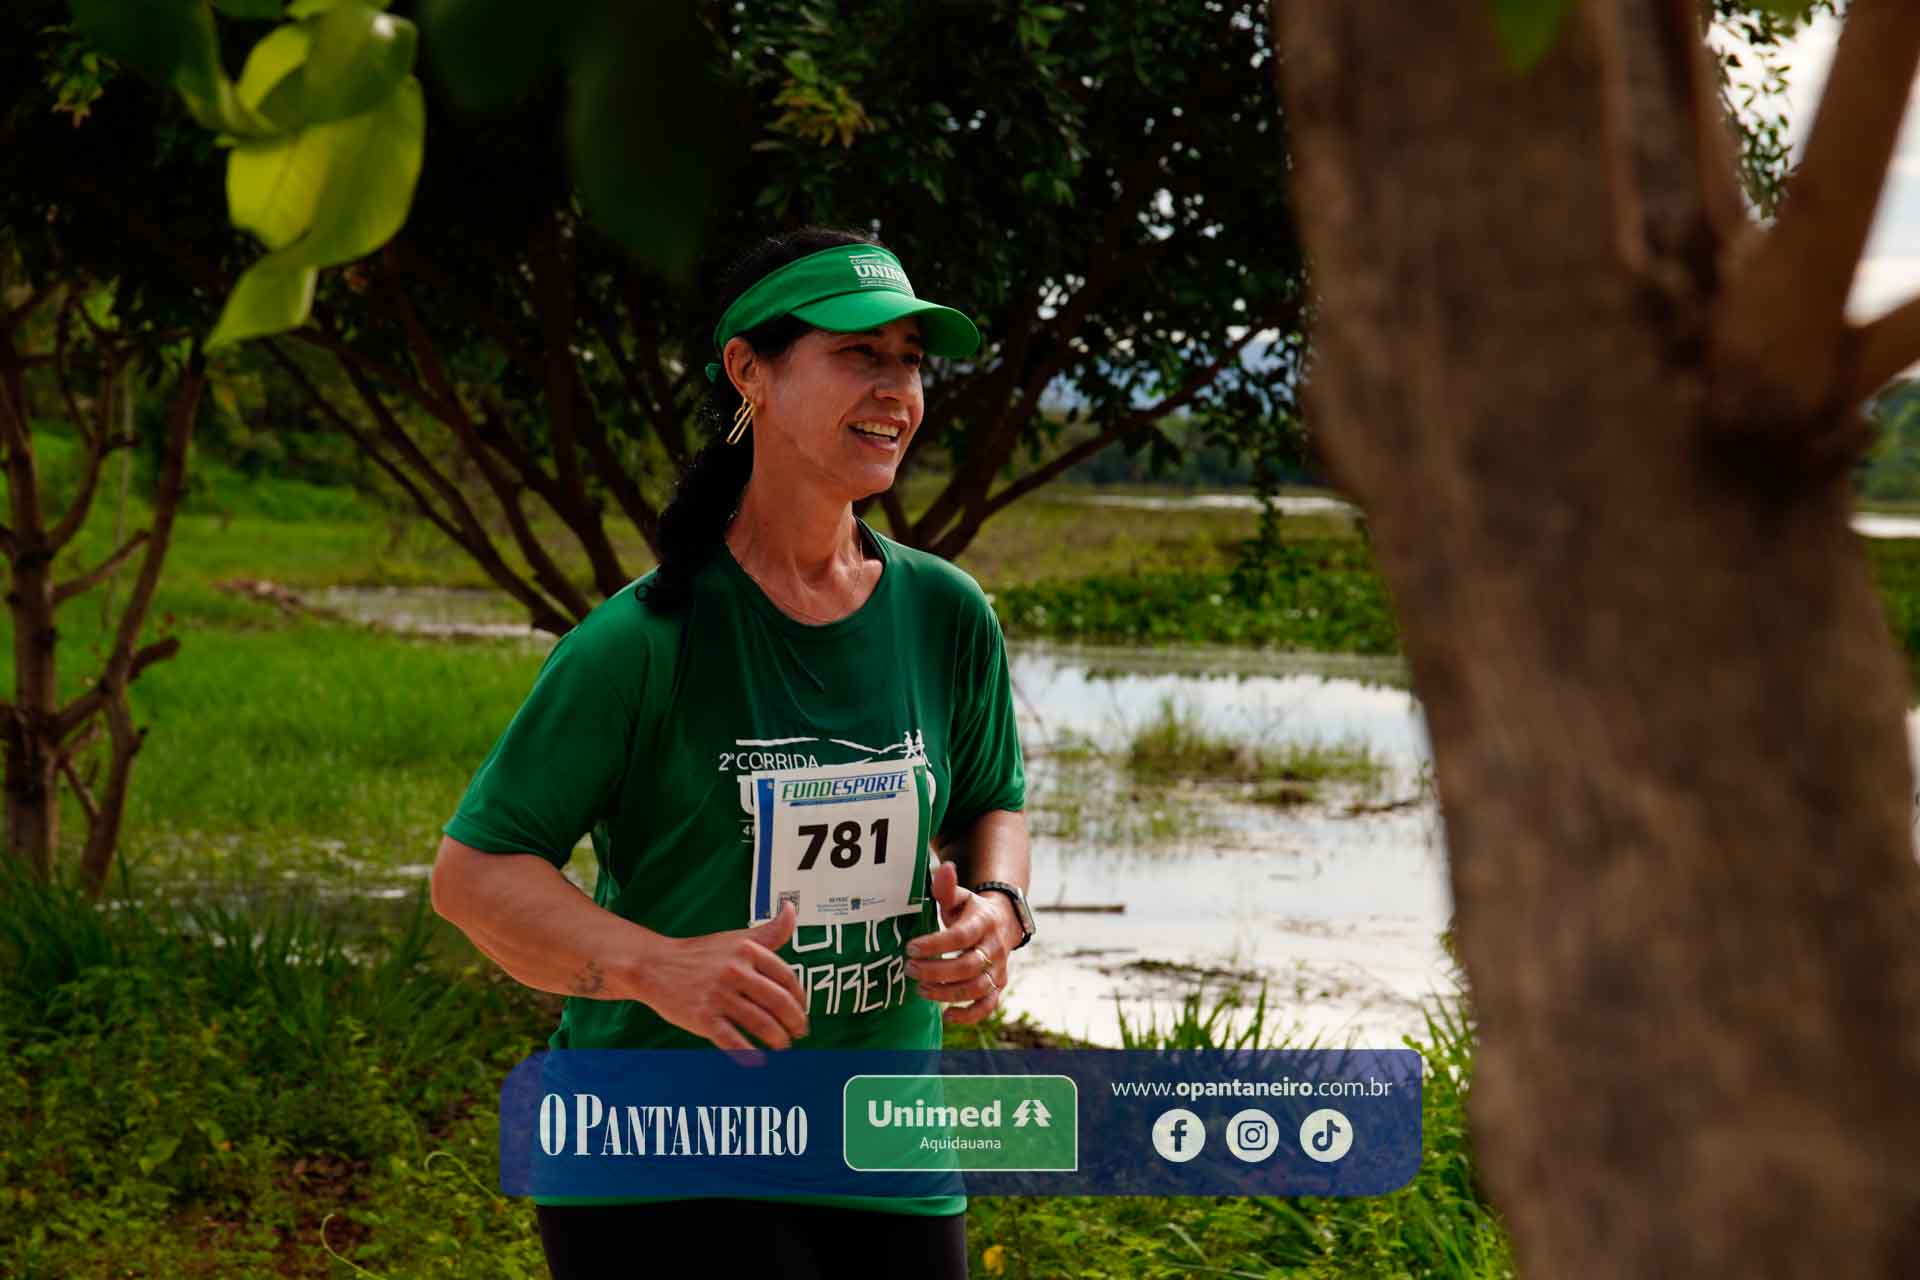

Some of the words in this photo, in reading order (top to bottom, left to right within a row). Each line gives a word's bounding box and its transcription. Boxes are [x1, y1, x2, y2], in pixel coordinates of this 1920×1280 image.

[736, 751, 820, 770] CORRIDA
[782, 773, 908, 800] FUNDESPORTE
[798, 818, 890, 871] 781
